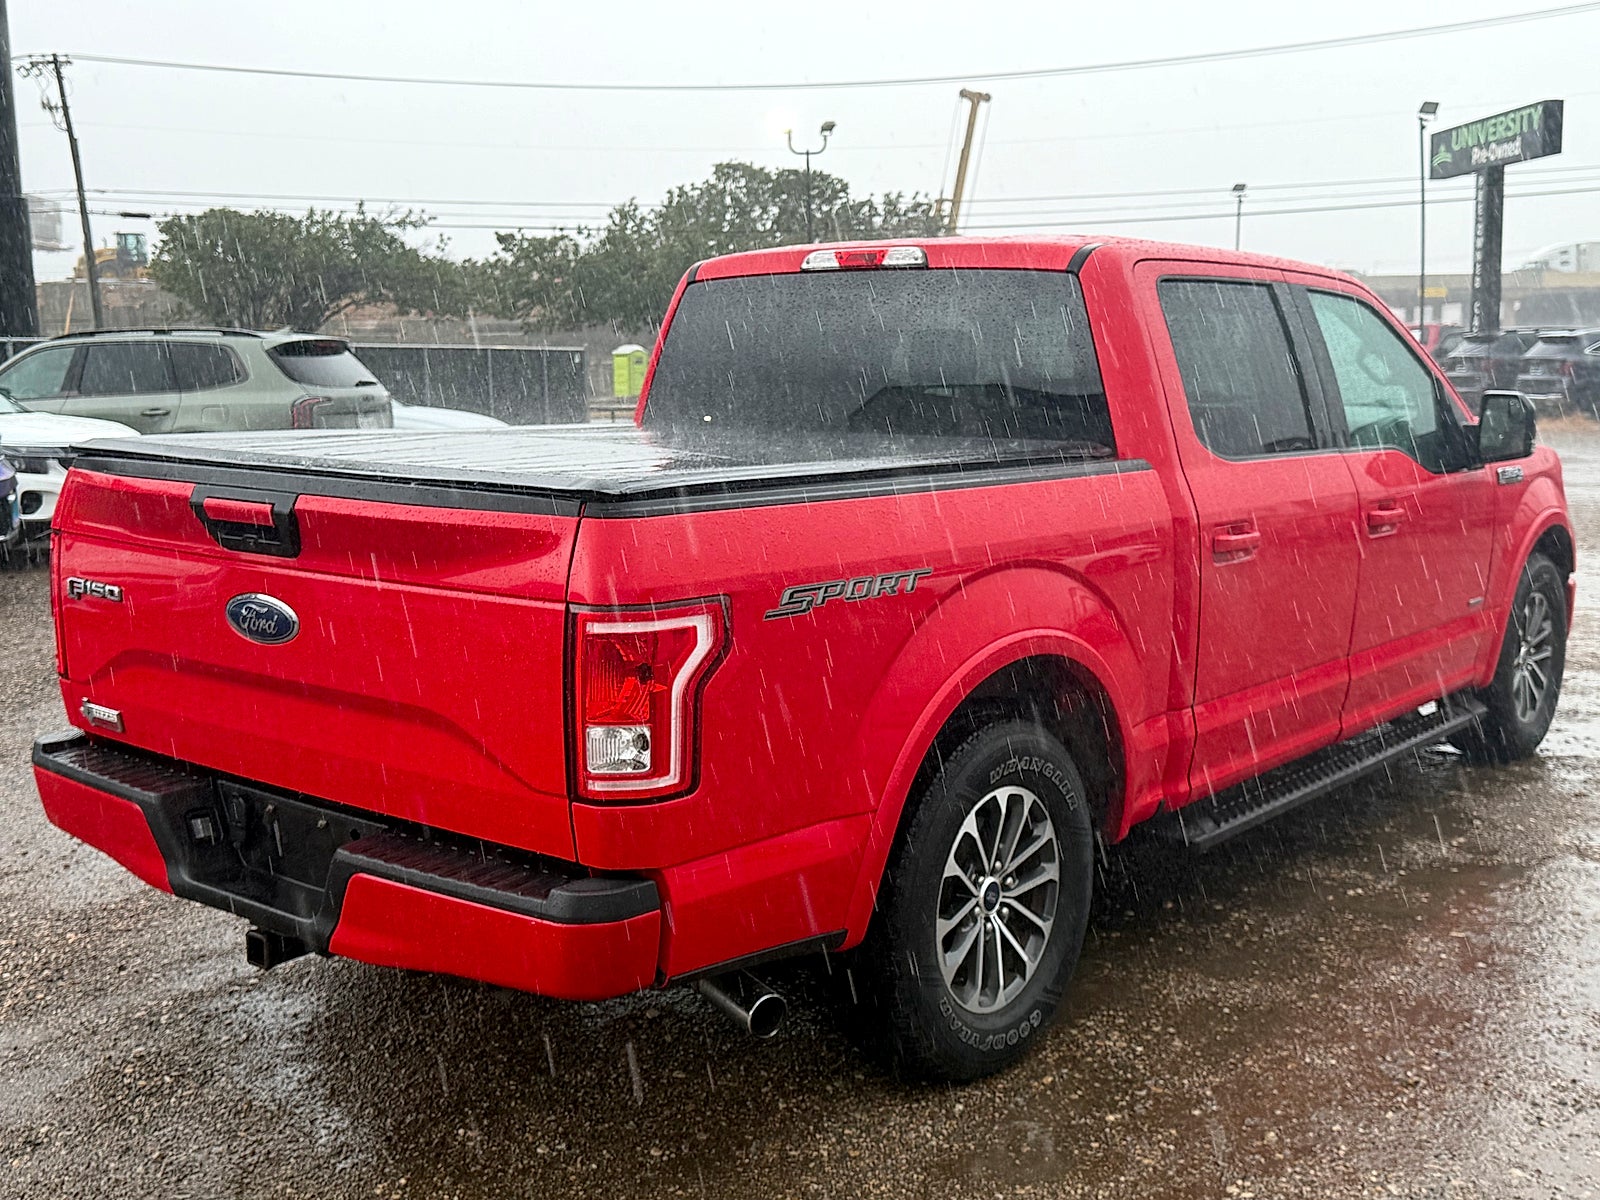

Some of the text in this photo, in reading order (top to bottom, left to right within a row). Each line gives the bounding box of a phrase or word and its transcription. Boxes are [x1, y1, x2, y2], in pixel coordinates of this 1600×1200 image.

[1451, 104, 1543, 150] UNIVERSITY
[239, 603, 279, 635] Ford
[763, 567, 933, 621] SPORT
[989, 756, 1078, 810] WRANGLER
[939, 997, 1041, 1050] GOODYEAR
